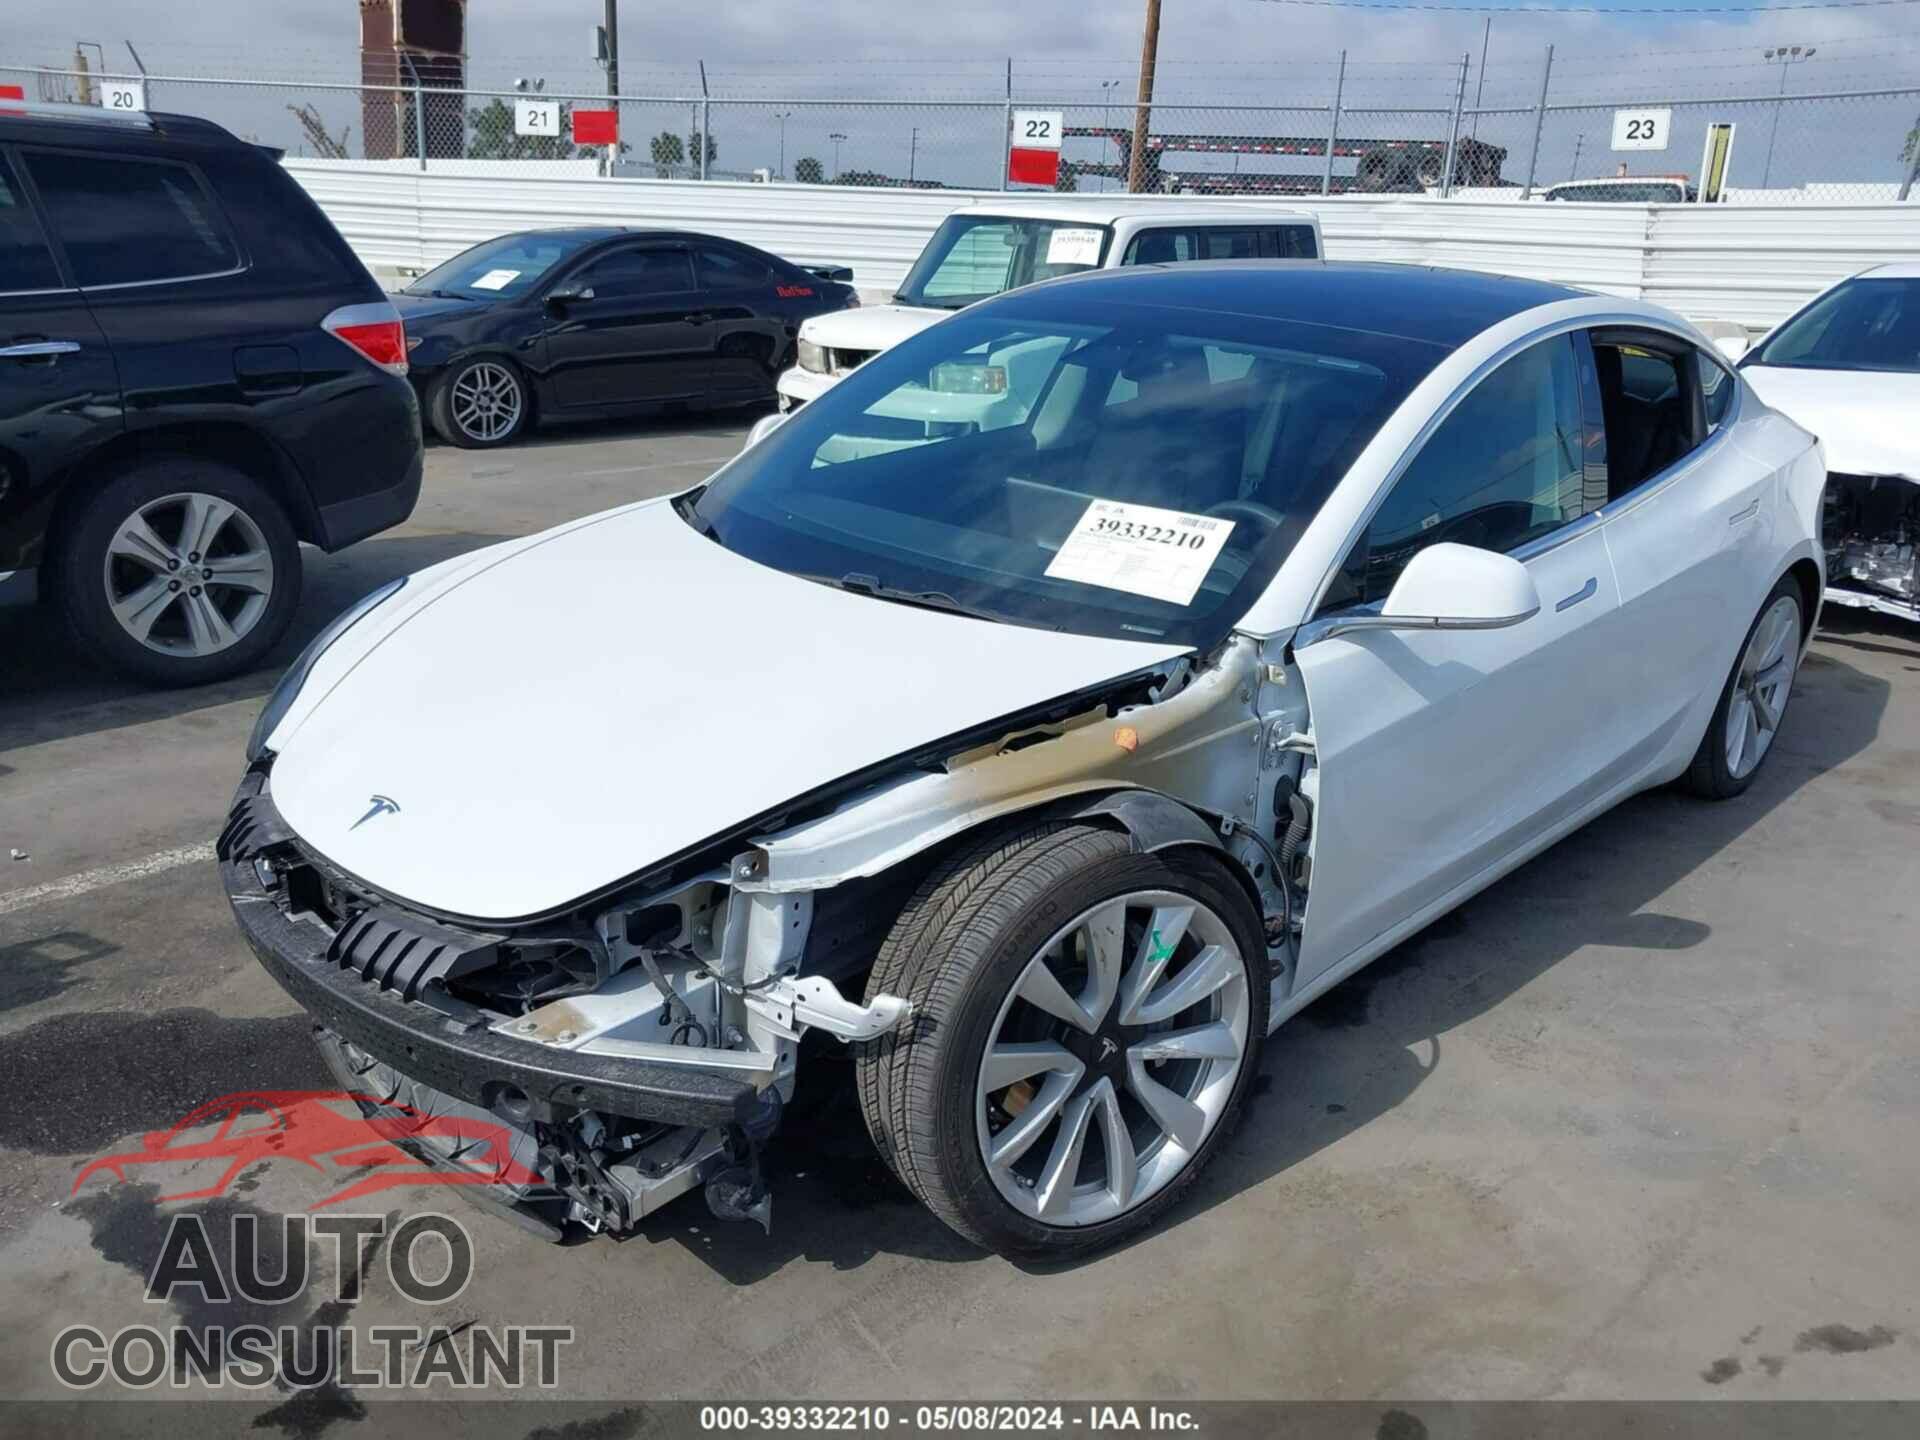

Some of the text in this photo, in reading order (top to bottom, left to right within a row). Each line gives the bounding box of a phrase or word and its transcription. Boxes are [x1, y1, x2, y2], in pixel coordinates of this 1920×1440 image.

[112, 91, 133, 108] 20
[527, 110, 548, 127] 21
[1025, 120, 1051, 138] 22
[1626, 119, 1656, 140] 23
[1088, 517, 1207, 551] 39332210
